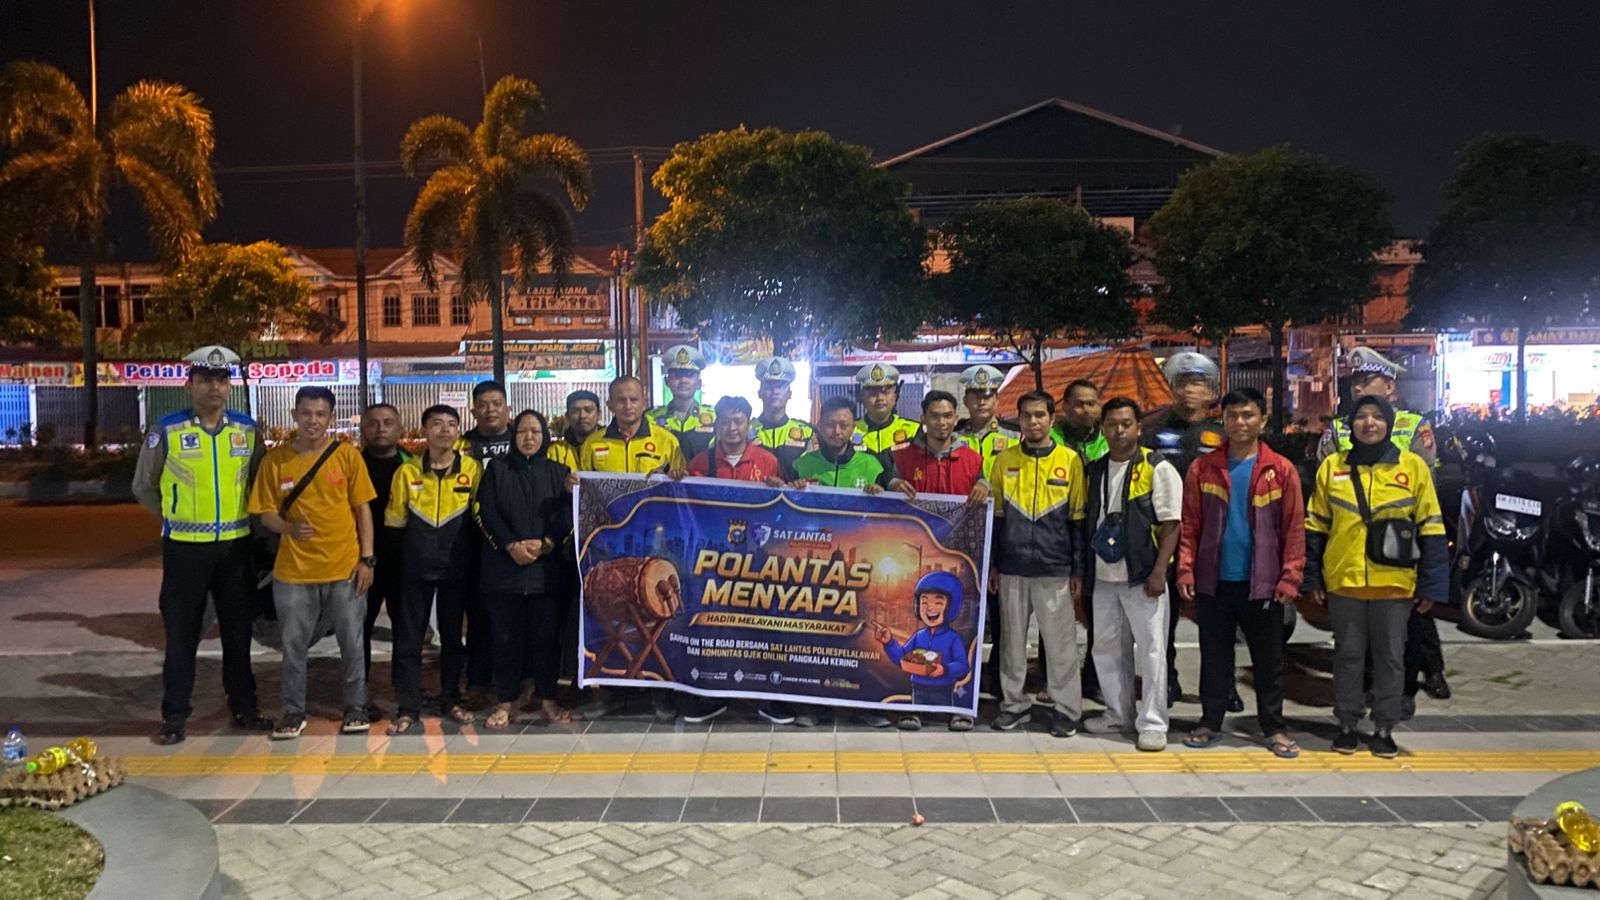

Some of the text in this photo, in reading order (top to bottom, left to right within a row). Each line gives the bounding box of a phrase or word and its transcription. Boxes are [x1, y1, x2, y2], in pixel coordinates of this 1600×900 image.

[531, 344, 569, 352] APPAREL
[569, 343, 600, 352] JERSEY
[249, 361, 335, 378] Sepeda
[773, 529, 833, 542] SAT LANTAS
[693, 549, 873, 588] POLANTAS
[701, 578, 858, 616] MENYAPA
[706, 614, 847, 633] HADIR MELAYANI MASYARAKAT
[690, 637, 700, 646] ON
[701, 638, 714, 647] THE
[715, 639, 734, 648] ROAD
[735, 640, 769, 651] BERSAMA
[770, 643, 783, 652] SAT
[784, 644, 811, 655] LANTAS
[687, 646, 700, 656] DAN
[701, 648, 742, 658] KOMUNITAS
[743, 650, 762, 659] OJEK
[763, 652, 788, 662] ONLINE
[830, 658, 859, 668] KERINCI
